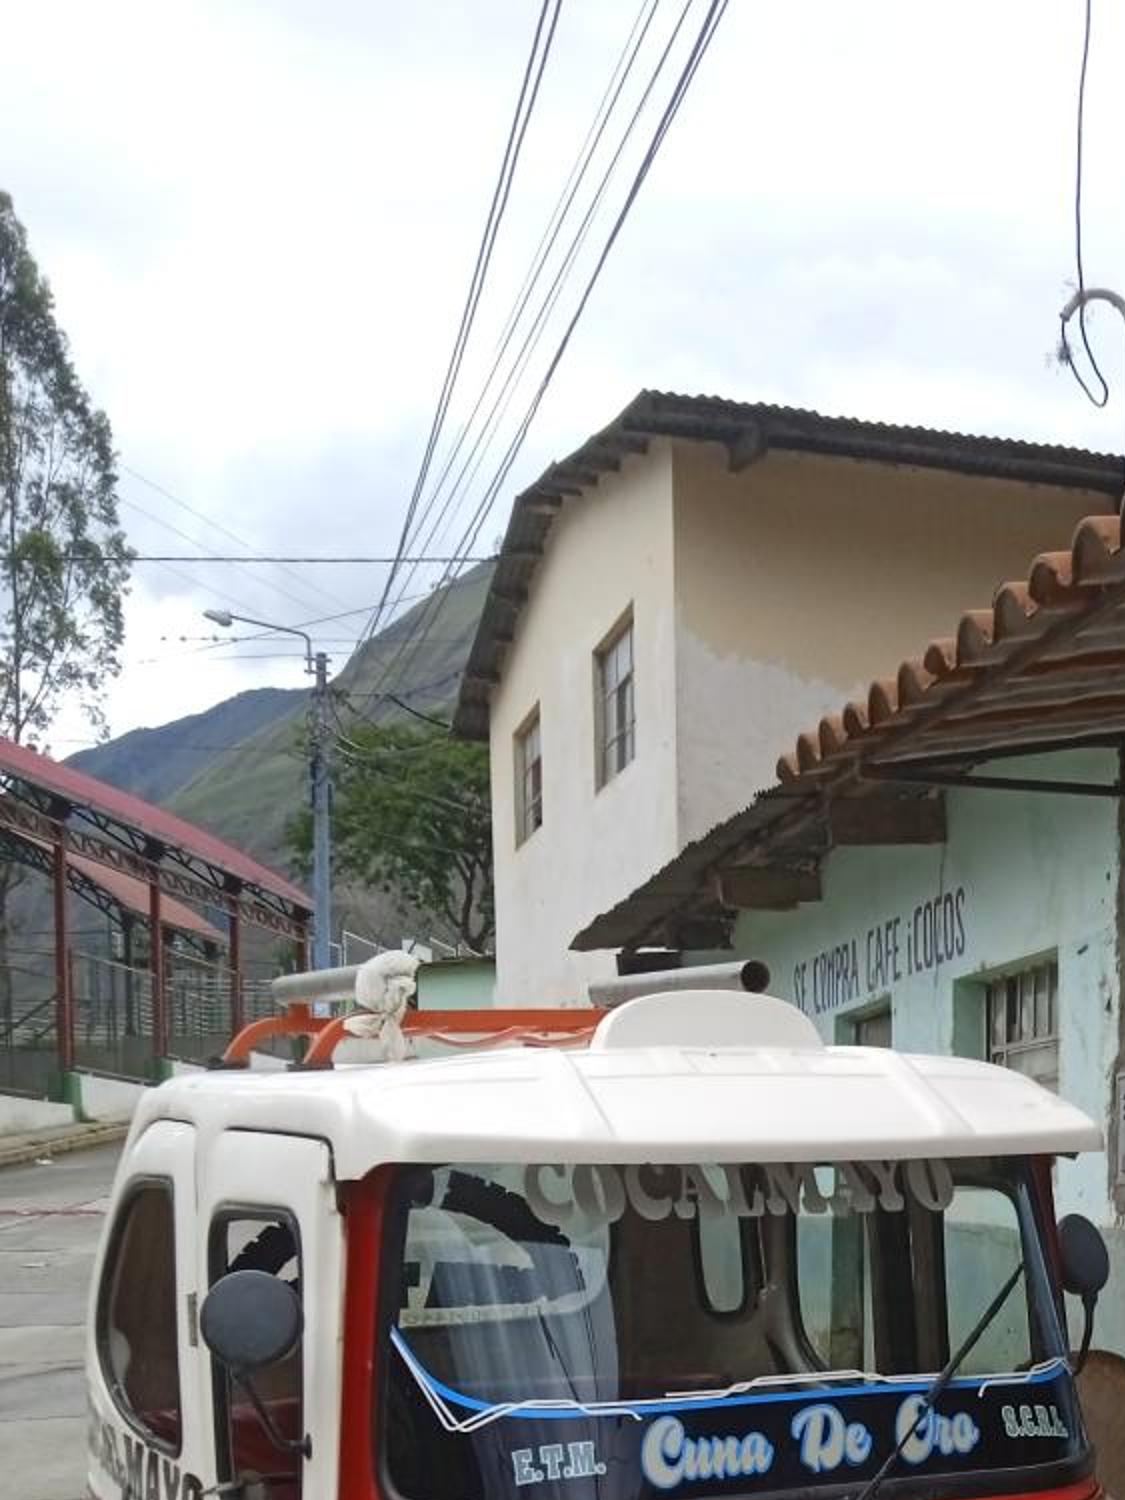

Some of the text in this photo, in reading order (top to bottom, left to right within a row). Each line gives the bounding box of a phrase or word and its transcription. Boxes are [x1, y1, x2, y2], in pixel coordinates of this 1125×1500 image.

[814, 939, 859, 1014] COMPRA
[867, 917, 901, 992] CAFE
[524, 1161, 954, 1222] COCALMAYO
[512, 1441, 606, 1486] E.T.M.
[642, 1415, 774, 1489] Cuna
[791, 1403, 872, 1473] De
[896, 1394, 980, 1464] Oro
